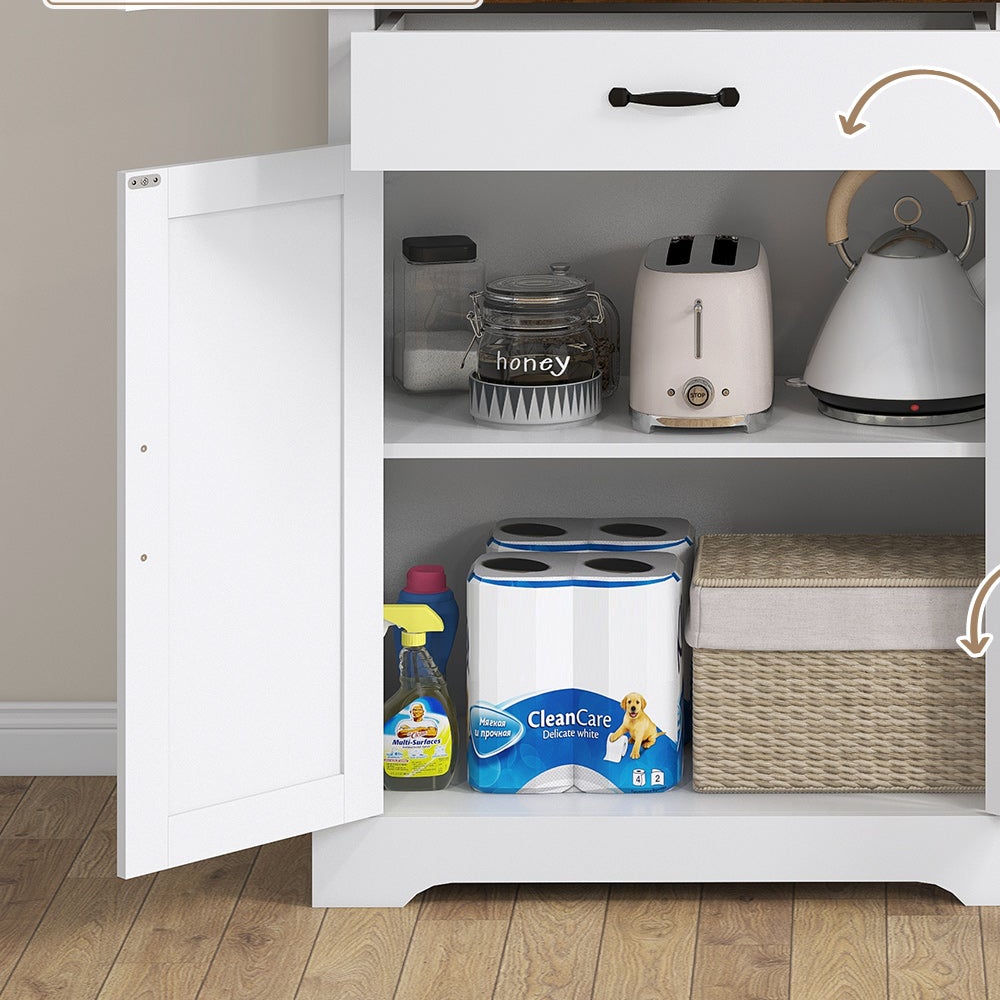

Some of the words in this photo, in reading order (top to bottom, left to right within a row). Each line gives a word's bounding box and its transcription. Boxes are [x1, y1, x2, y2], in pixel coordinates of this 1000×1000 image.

[496, 350, 571, 376] honey
[479, 717, 506, 728] Мягкая
[527, 708, 612, 729] CleanCare
[480, 729, 511, 740] прочная
[542, 728, 575, 740] Delicate
[577, 728, 599, 739] white
[635, 775, 641, 783] 4
[655, 774, 660, 783] 2
